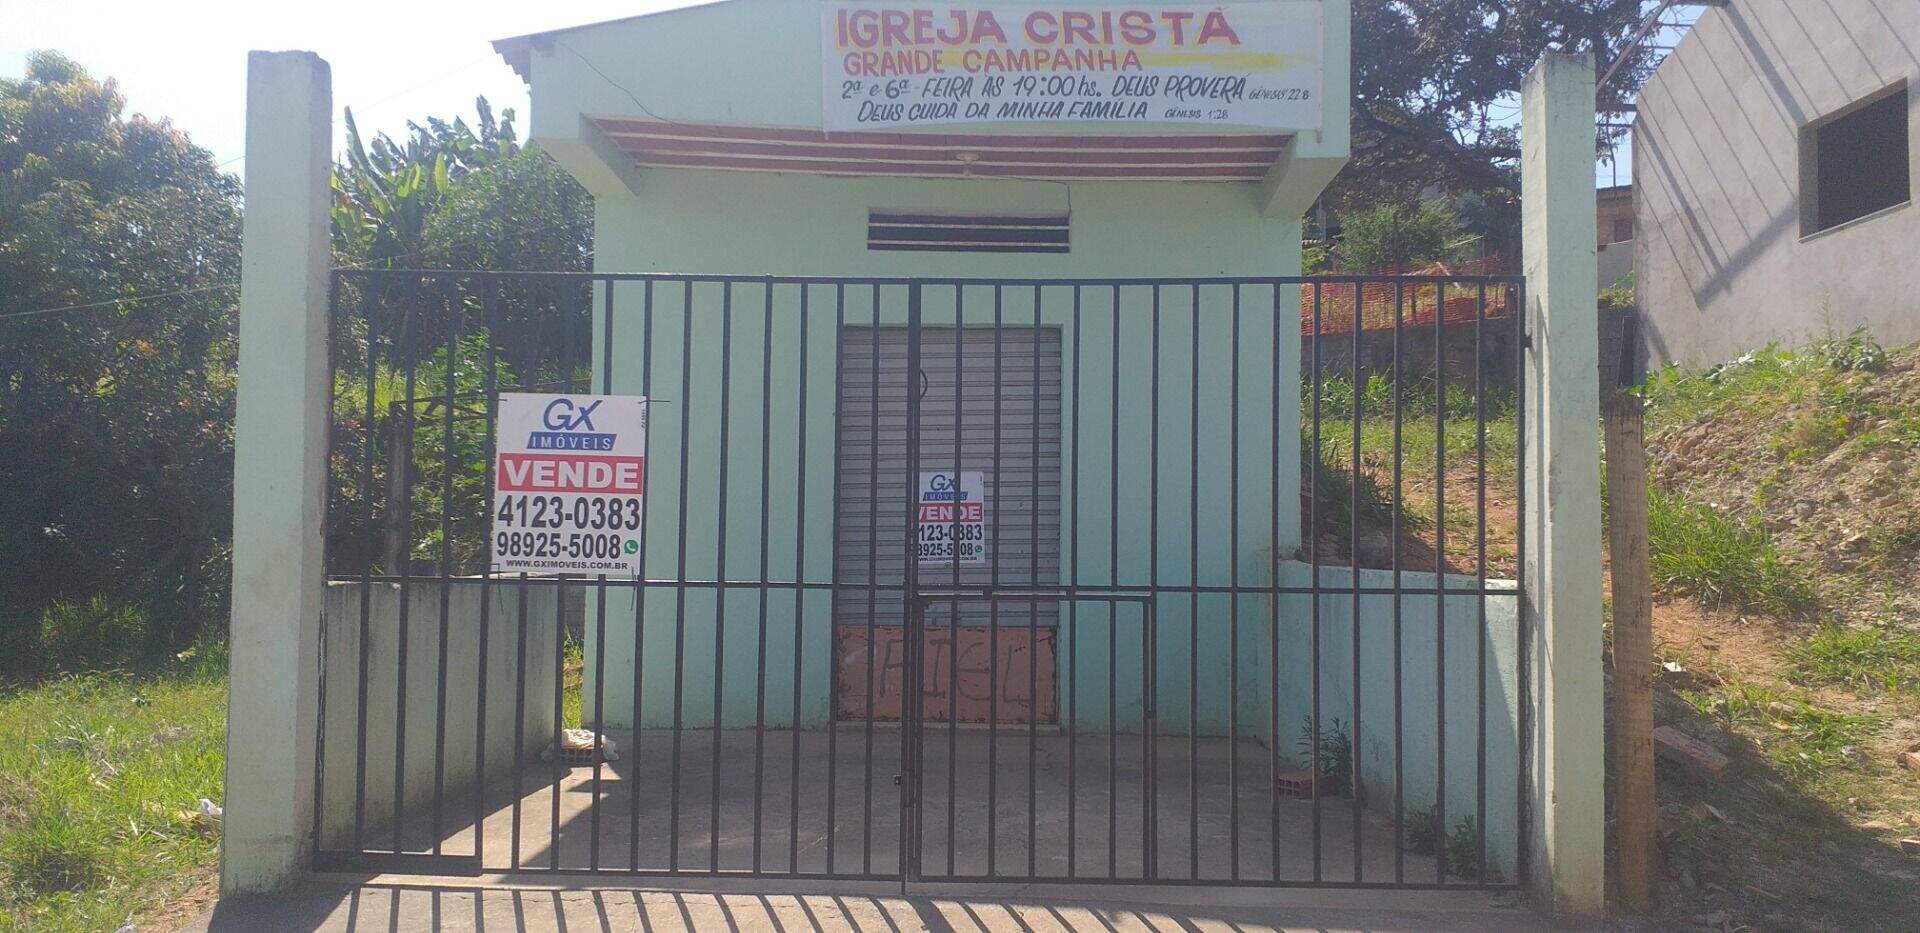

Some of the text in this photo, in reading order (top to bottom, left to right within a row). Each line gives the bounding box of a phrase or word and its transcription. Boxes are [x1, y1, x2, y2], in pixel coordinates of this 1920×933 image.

[837, 8, 1008, 48] IGREJA
[843, 48, 1143, 77] GRANDE CAMPANHA
[869, 84, 882, 97] e
[1013, 75, 1075, 97] 19:00
[1112, 75, 1159, 97] DEUS
[857, 100, 904, 122] DEUS
[908, 102, 958, 121] CUIDA
[965, 102, 990, 118] DA
[997, 101, 1064, 119] MINHA
[543, 398, 602, 431] GX
[532, 435, 612, 450] IMÓVEIS
[503, 459, 639, 490] VENDE
[498, 495, 640, 531] 4123-0383
[497, 531, 621, 559] 98925-5008
[917, 524, 982, 541] 123-0383
[917, 543, 973, 556] 8925-508
[506, 559, 628, 570] WWW.GXIMOVEIS.COM.BR
